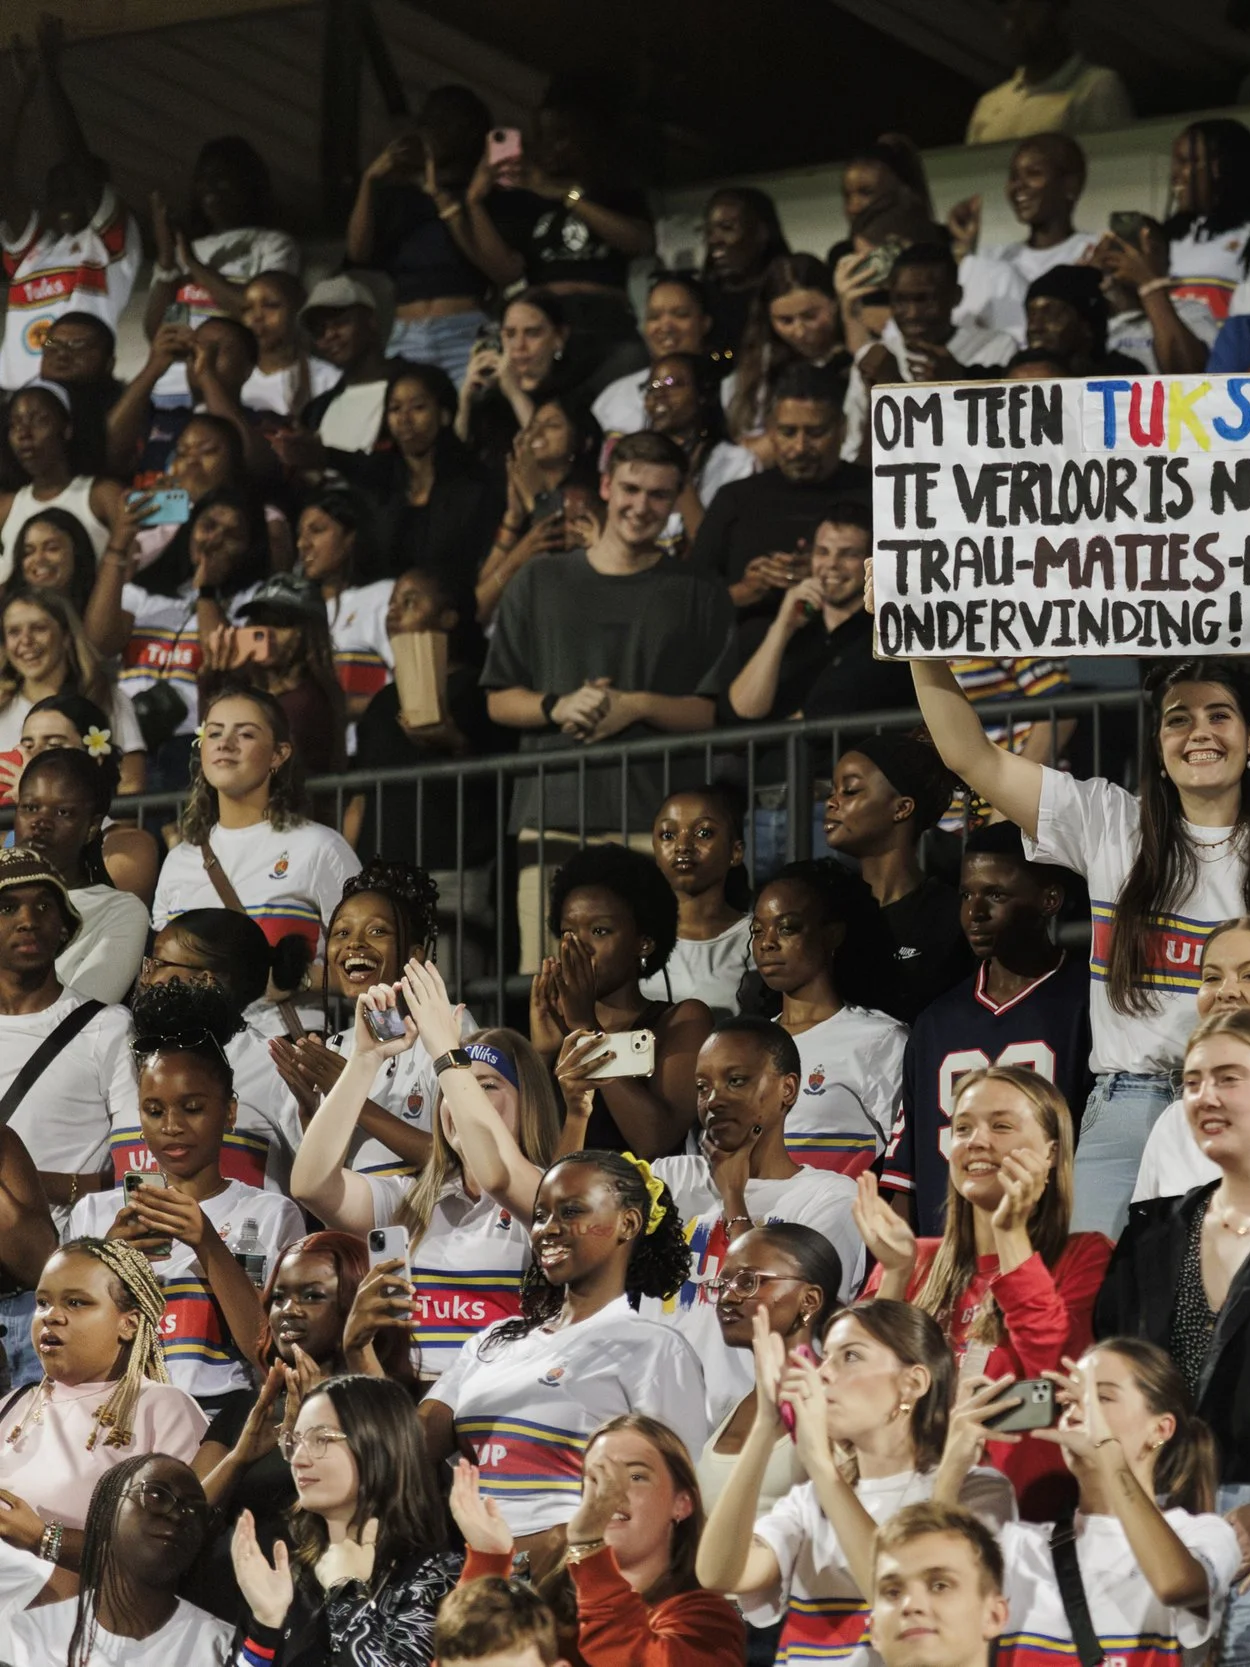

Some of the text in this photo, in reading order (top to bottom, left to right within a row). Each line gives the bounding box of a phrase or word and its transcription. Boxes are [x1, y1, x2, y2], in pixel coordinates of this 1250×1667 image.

[874, 392, 943, 451] OM
[954, 383, 1064, 448] TEEN
[875, 462, 941, 529] TE
[879, 591, 1243, 656] ONDERVINDING!
[416, 1295, 486, 1320] Tuks
